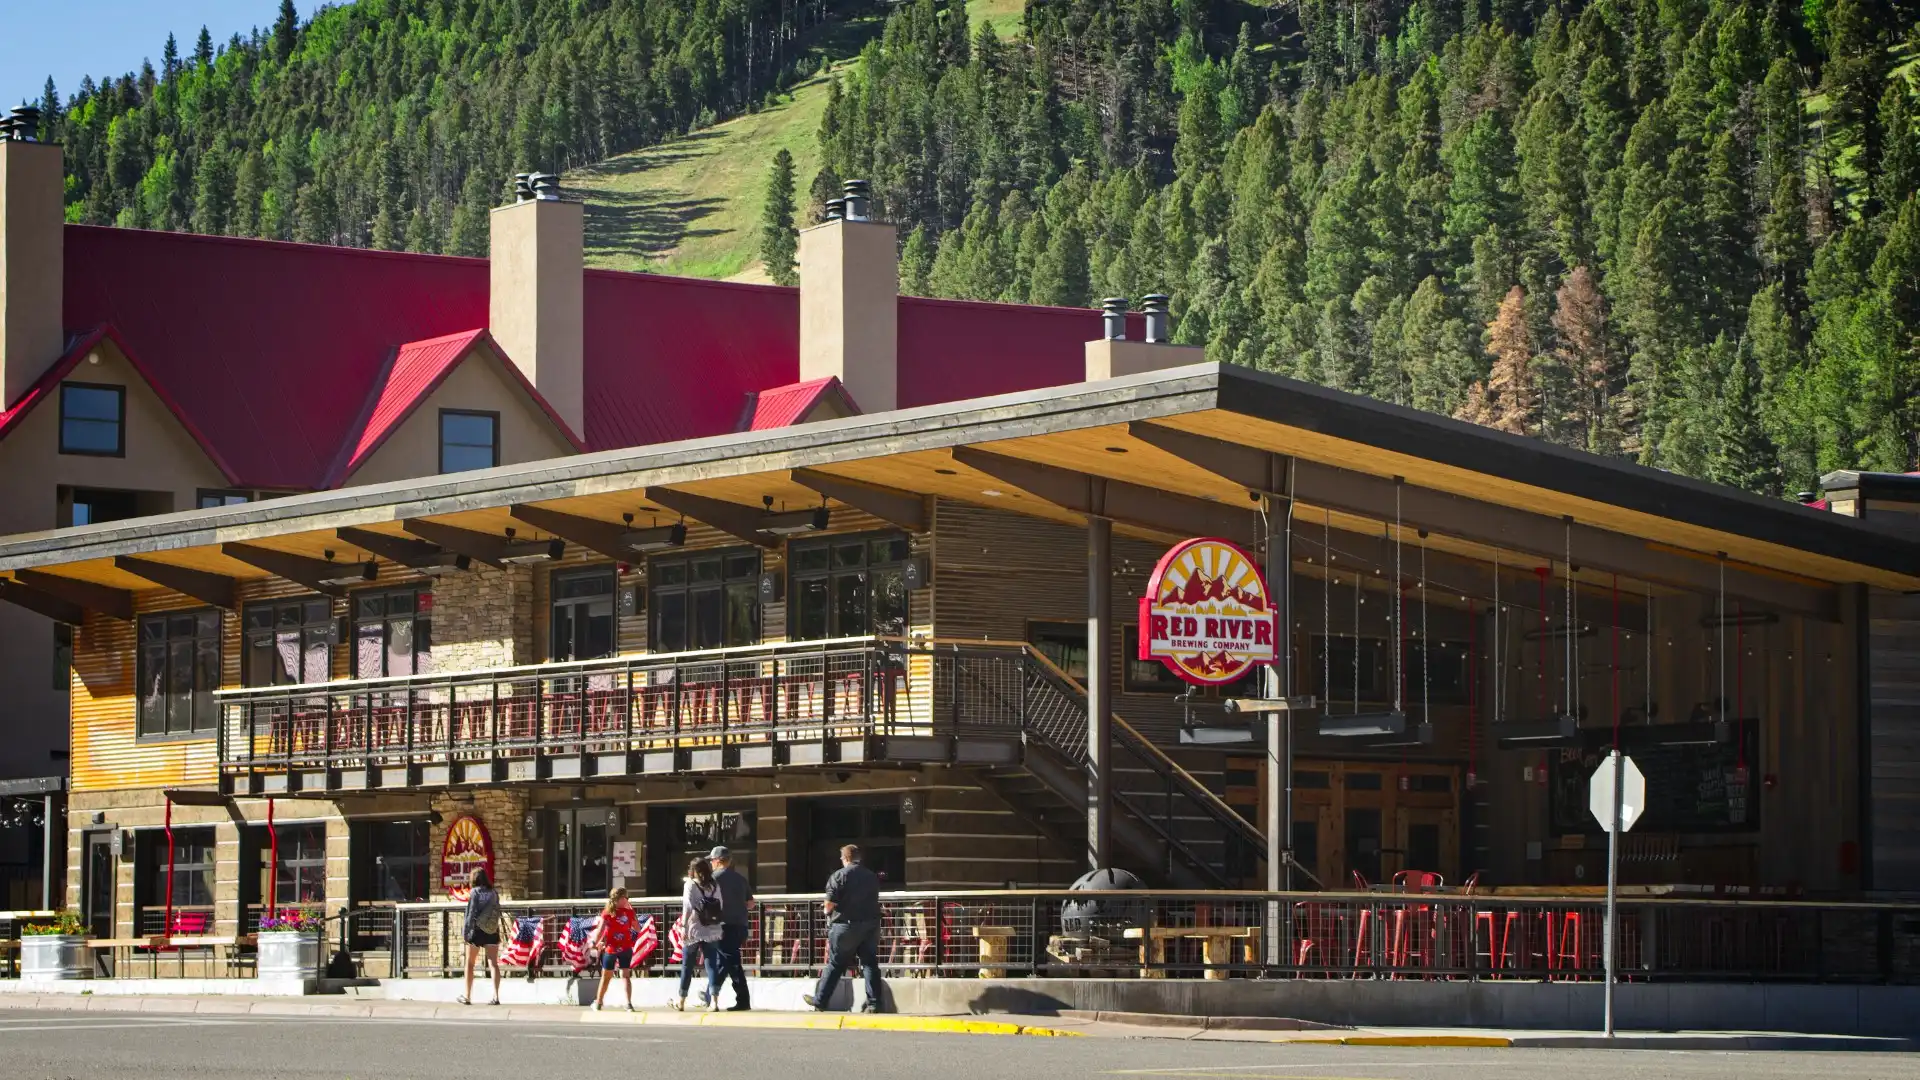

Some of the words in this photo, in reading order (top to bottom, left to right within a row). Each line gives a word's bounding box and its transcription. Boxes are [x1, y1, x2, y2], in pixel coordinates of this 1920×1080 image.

[1151, 615, 1198, 640] RED
[1205, 618, 1272, 645] RIVER
[1171, 639, 1208, 649] BREWING
[1213, 641, 1250, 651] COMPANY
